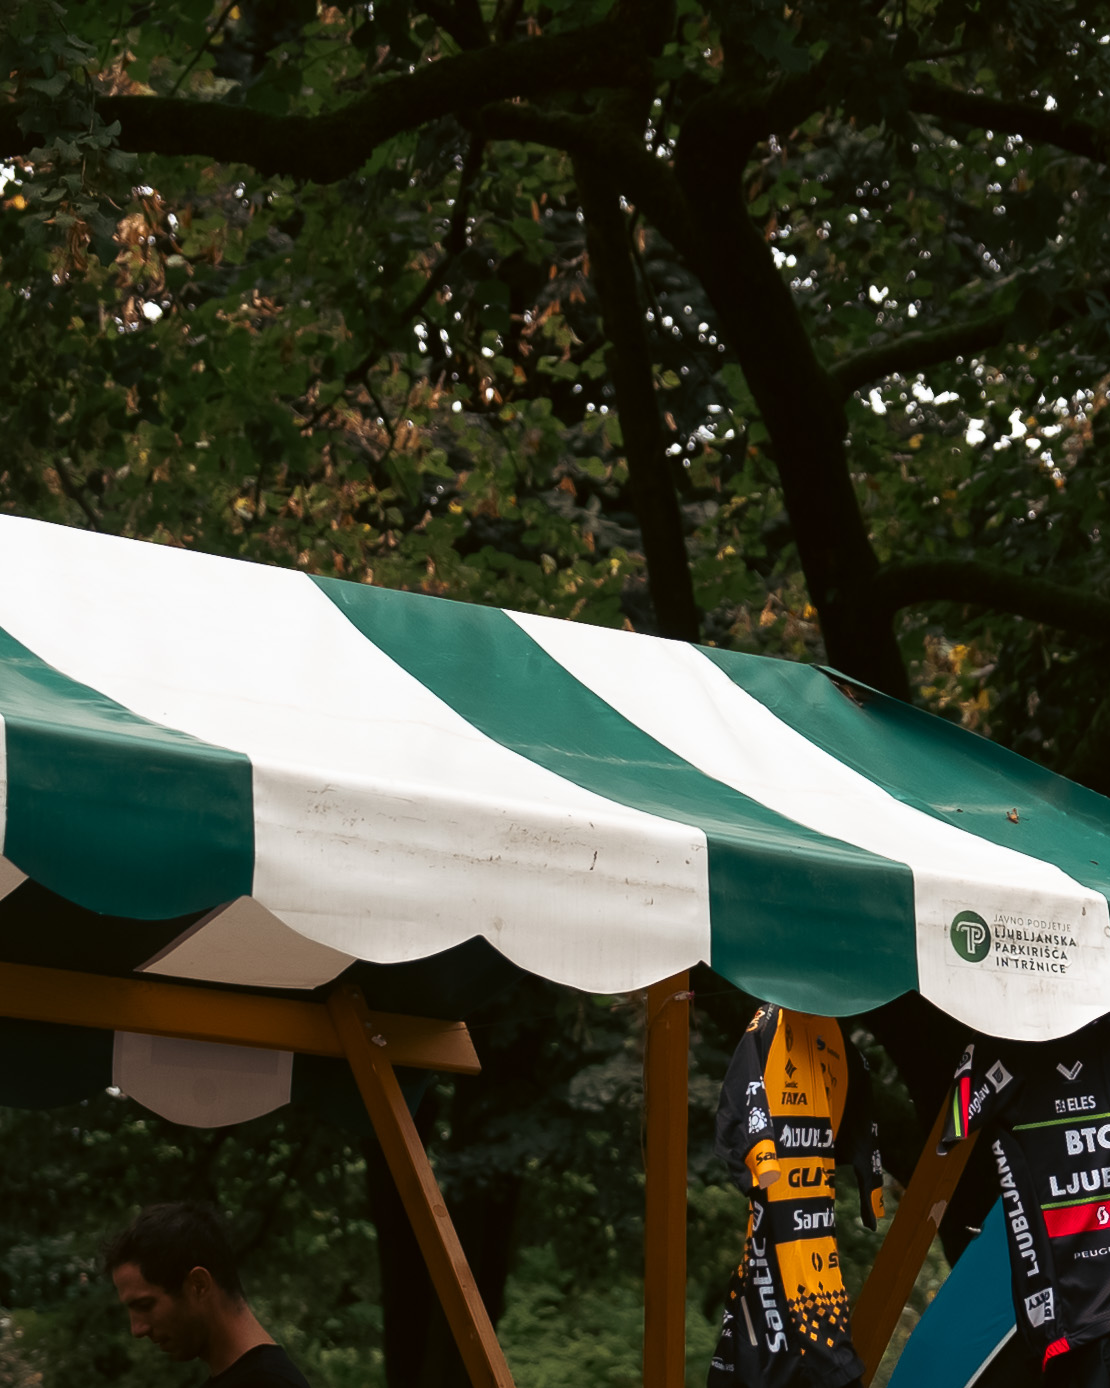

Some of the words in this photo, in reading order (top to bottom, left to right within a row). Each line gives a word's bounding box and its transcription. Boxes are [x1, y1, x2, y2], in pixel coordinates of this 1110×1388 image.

[994, 914, 1024, 926] JAVNO
[1027, 918, 1072, 932] PODJETJE
[995, 928, 1077, 947] LJUBLJANSKA
[995, 941, 1068, 960] PARKIRIŠČA
[996, 958, 1008, 967] IN
[1013, 957, 1067, 974] TRŽNICE
[1067, 1095, 1096, 1111] ELES
[992, 1139, 1040, 1277] LJUBLJANA
